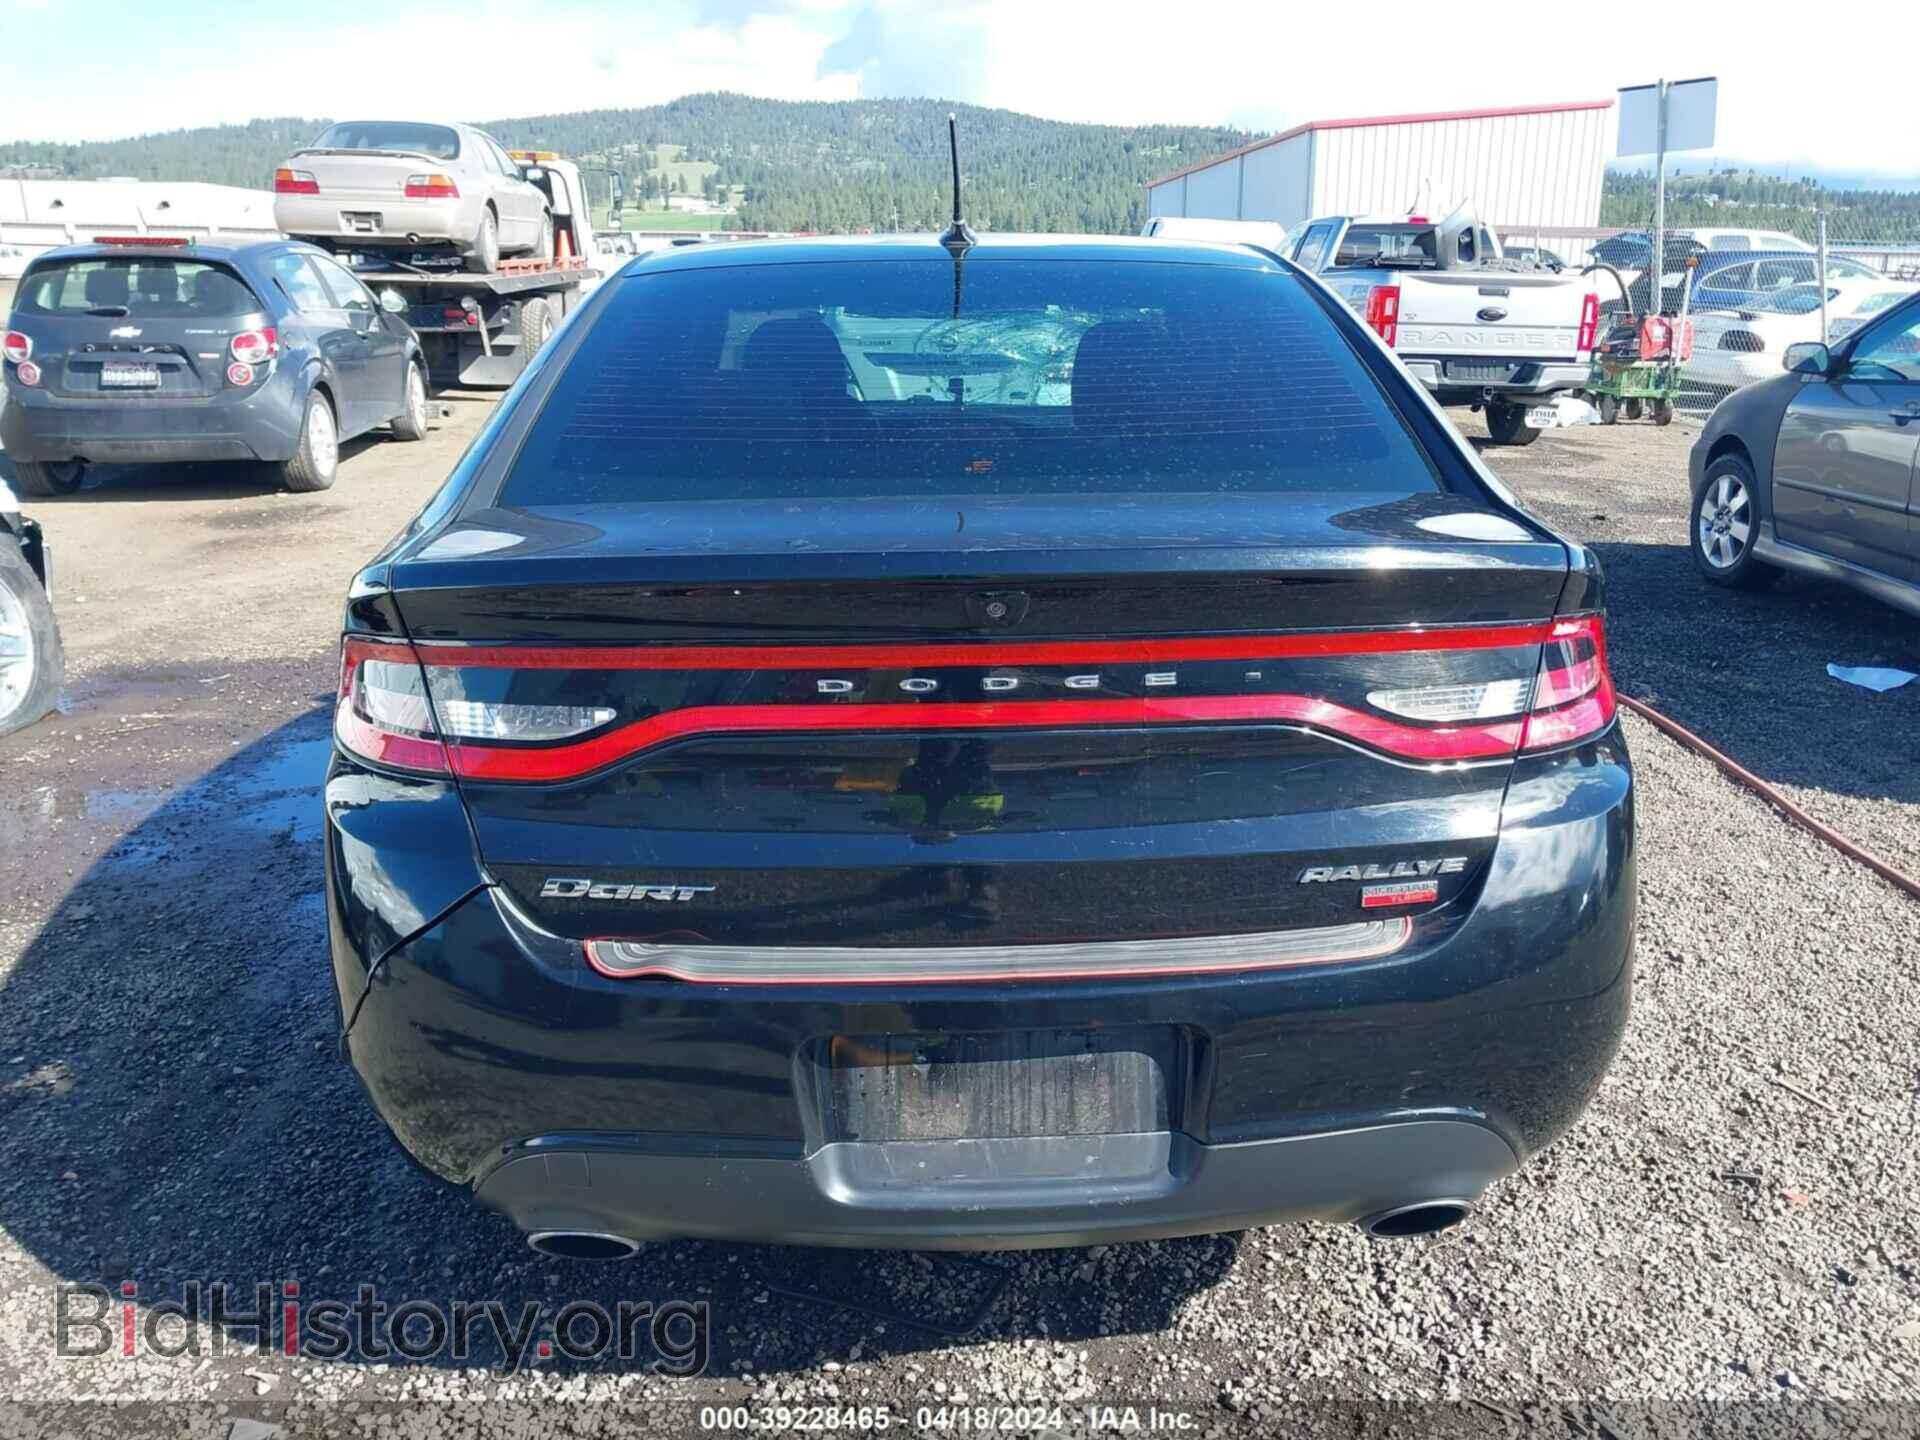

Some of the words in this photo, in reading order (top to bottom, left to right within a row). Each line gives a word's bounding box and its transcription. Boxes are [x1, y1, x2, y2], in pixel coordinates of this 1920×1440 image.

[1401, 330, 1573, 345] RANGER
[816, 670, 1178, 694] DODGE
[1297, 856, 1468, 884] RALLYE
